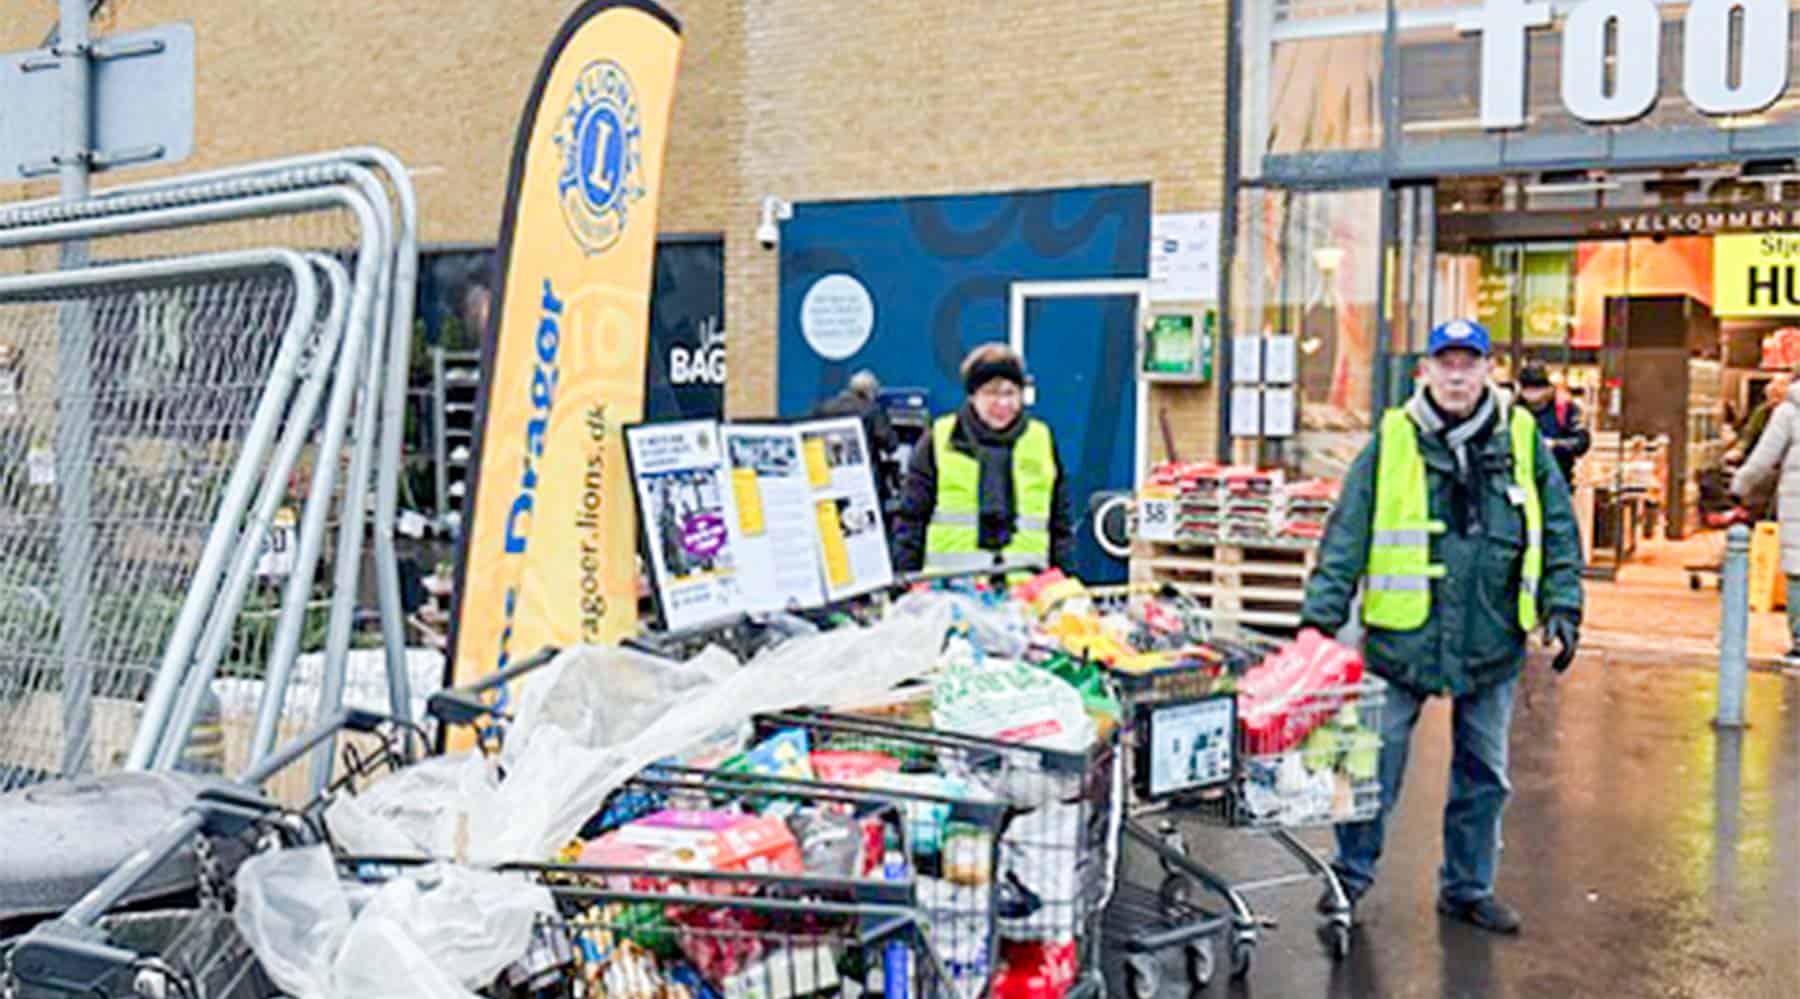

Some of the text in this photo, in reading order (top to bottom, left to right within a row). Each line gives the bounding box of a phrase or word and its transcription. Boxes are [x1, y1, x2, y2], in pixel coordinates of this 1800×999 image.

[1453, 0, 1789, 128] foo
[1620, 211, 1783, 231] VELKOMMEN
[671, 348, 727, 383] BAG
